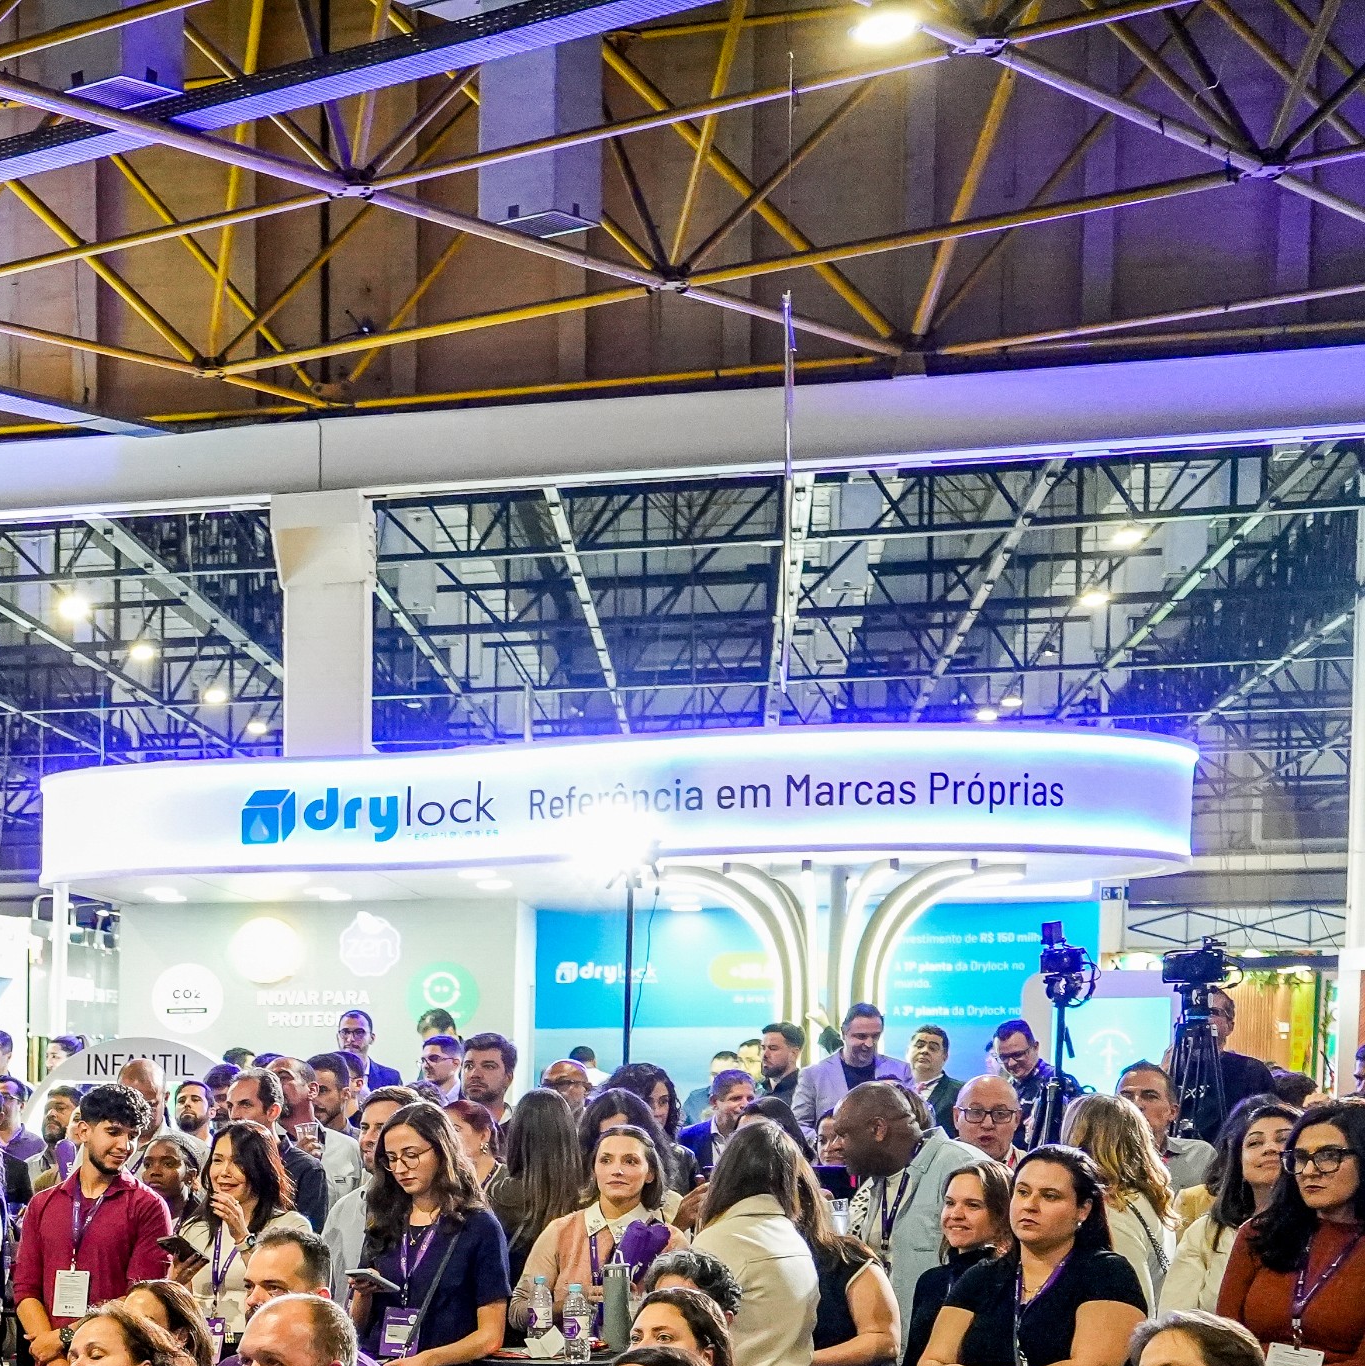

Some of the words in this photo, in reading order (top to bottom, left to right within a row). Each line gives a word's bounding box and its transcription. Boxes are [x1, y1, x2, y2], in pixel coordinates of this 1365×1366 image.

[528, 779, 703, 821] Referência
[717, 781, 771, 809] em
[785, 774, 916, 806] Marcas
[929, 772, 1064, 814] Próprias
[303, 781, 496, 842] drylock
[980, 931, 994, 944] R$
[1017, 931, 1043, 943] milh
[970, 961, 1009, 973] Drylock
[322, 989, 371, 1006] PARA
[269, 1011, 340, 1028] PROTEG
[967, 1005, 1005, 1017] Drylock
